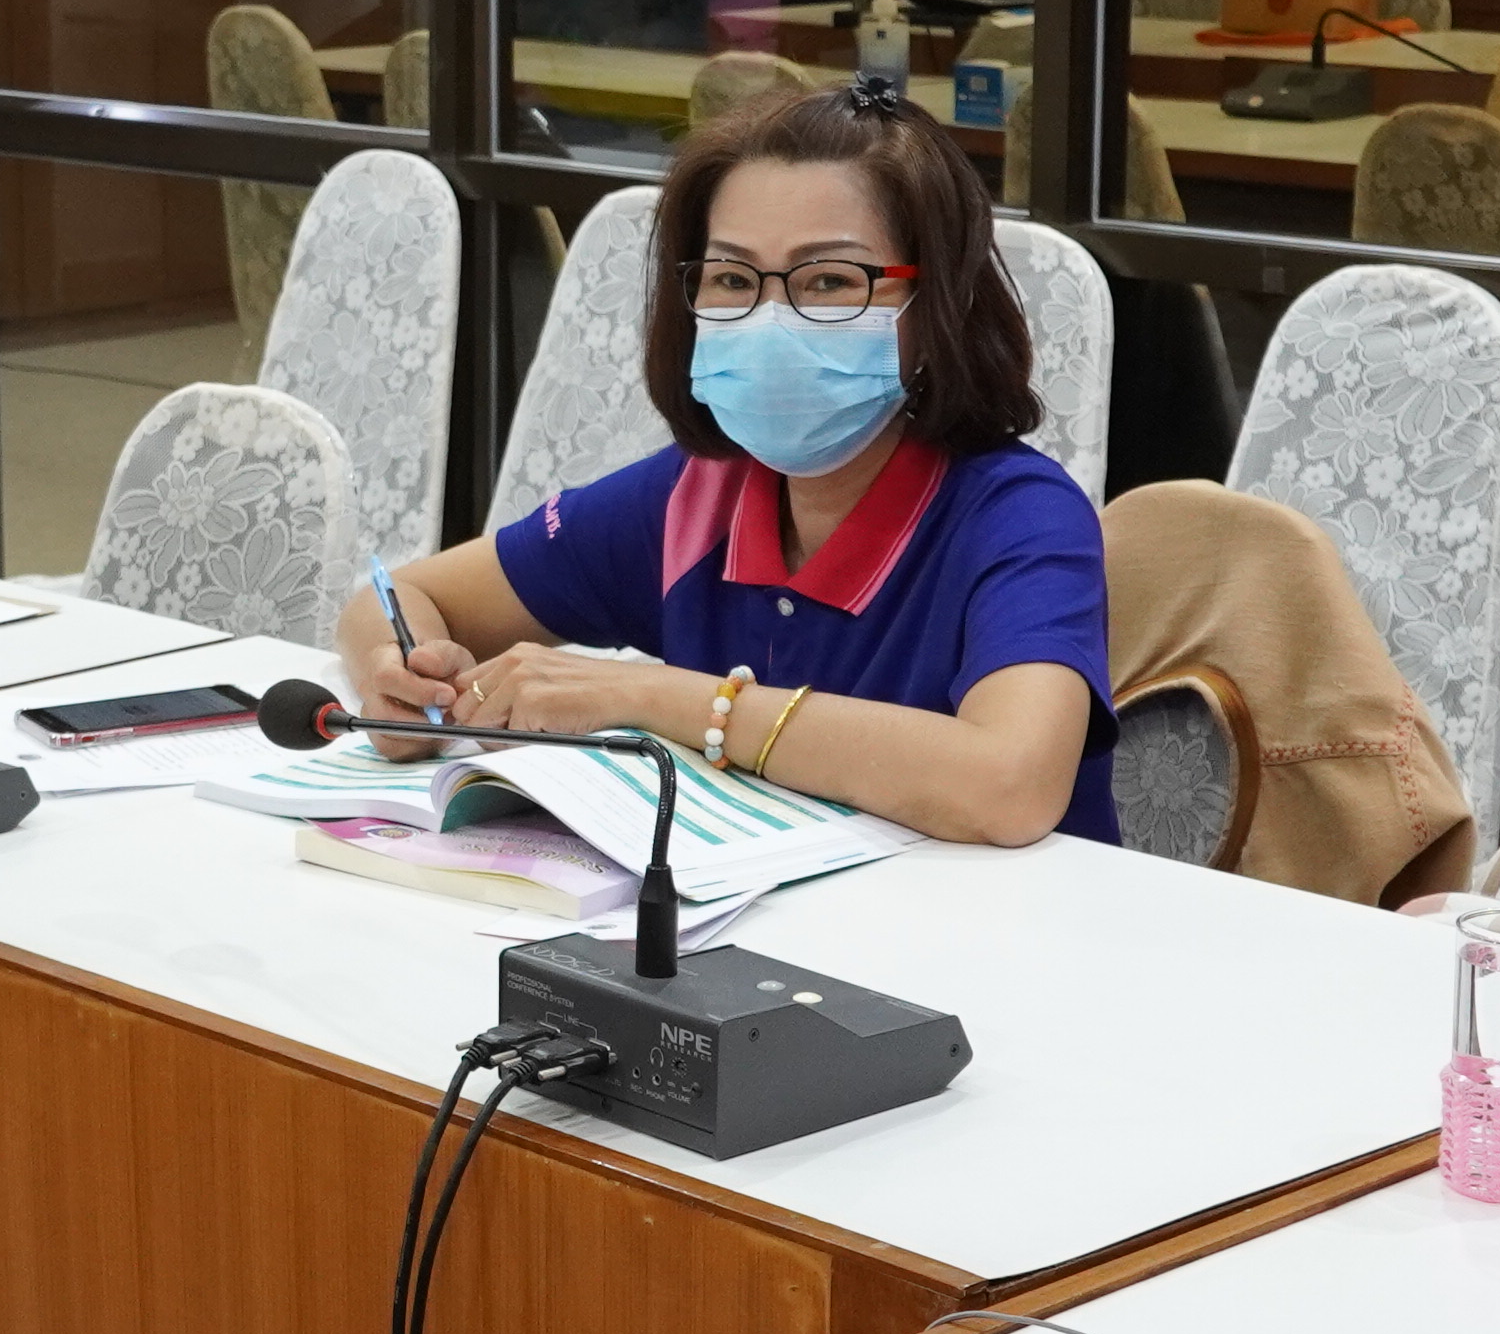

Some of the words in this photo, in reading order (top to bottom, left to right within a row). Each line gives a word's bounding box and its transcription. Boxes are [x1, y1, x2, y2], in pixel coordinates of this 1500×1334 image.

[507, 980, 549, 1003] CONFERENCE
[549, 994, 575, 1009] SYSTEM
[660, 1021, 714, 1056] NPE
[660, 1040, 713, 1063] RESEARCH
